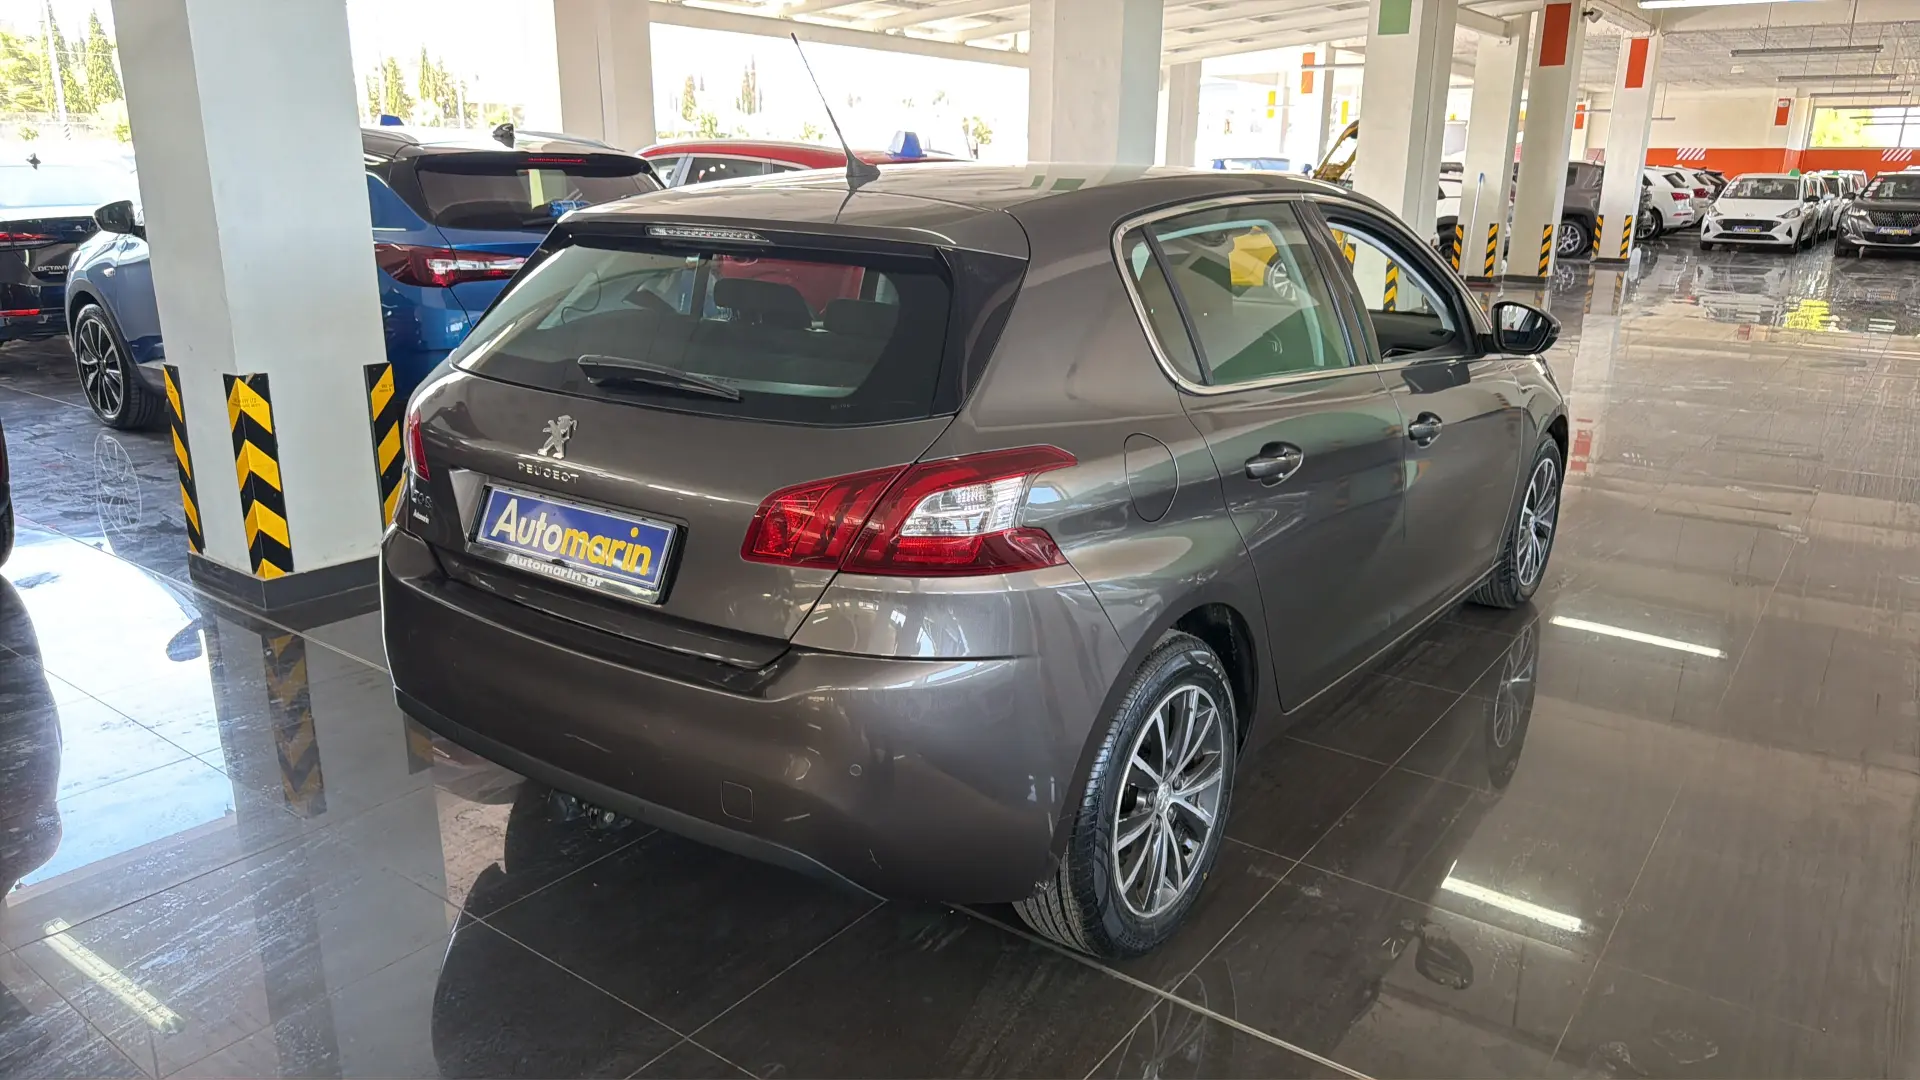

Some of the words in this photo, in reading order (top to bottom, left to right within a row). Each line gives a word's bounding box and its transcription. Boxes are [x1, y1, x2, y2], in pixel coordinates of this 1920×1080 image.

[517, 461, 579, 483] PEUGEOT
[490, 498, 652, 576] Automarin
[506, 553, 602, 588] Automarin.gr
